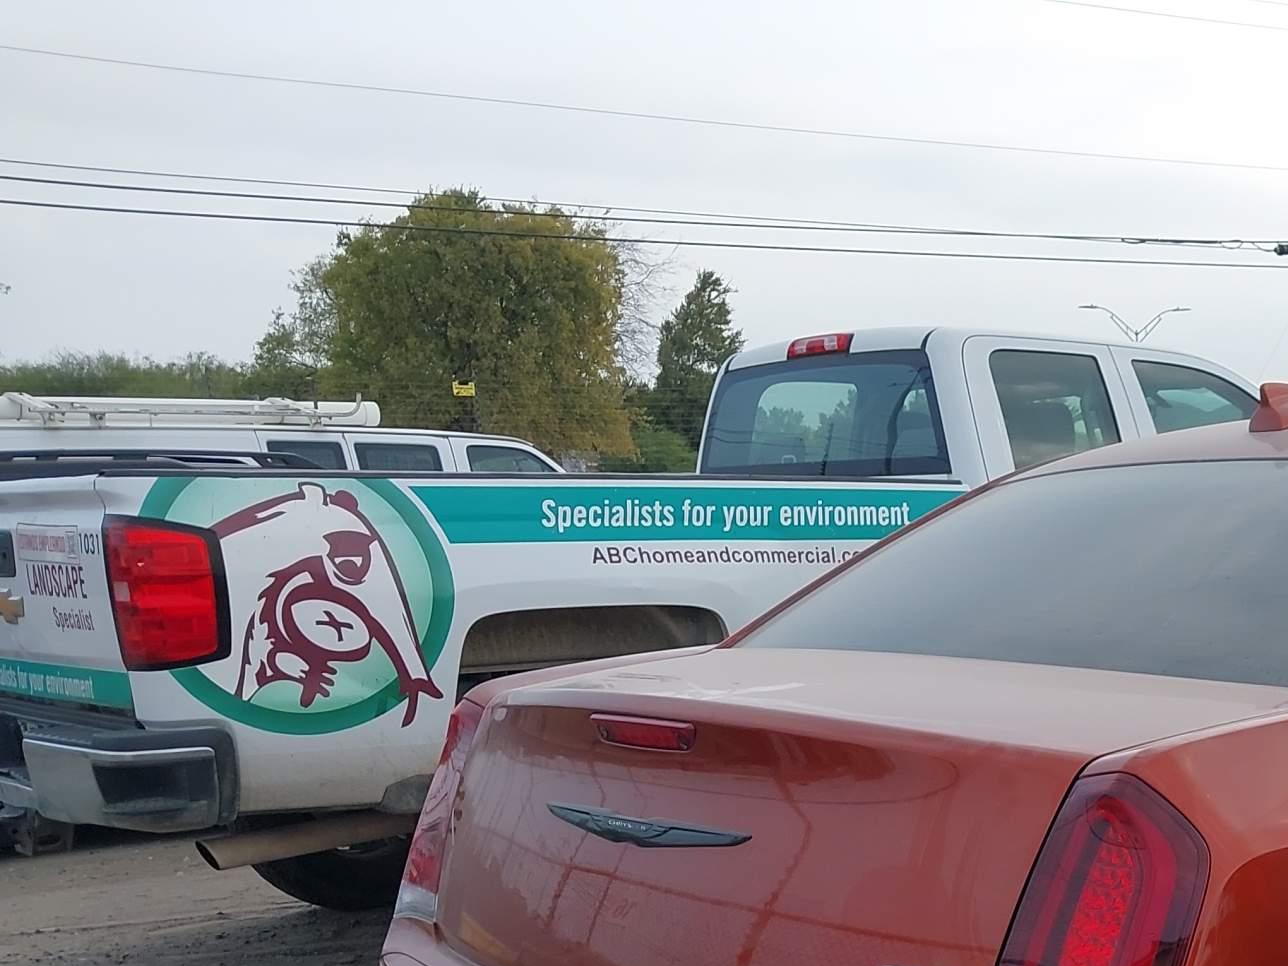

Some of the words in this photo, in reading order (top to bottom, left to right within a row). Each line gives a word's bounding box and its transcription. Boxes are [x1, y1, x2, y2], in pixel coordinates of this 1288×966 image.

[541, 499, 675, 533] Specialists
[682, 499, 716, 526] for
[723, 505, 772, 532] your
[779, 500, 911, 526] environment
[79, 532, 100, 554] 1031
[26, 563, 88, 599] LANDSCAPE
[52, 606, 95, 632] Specialist
